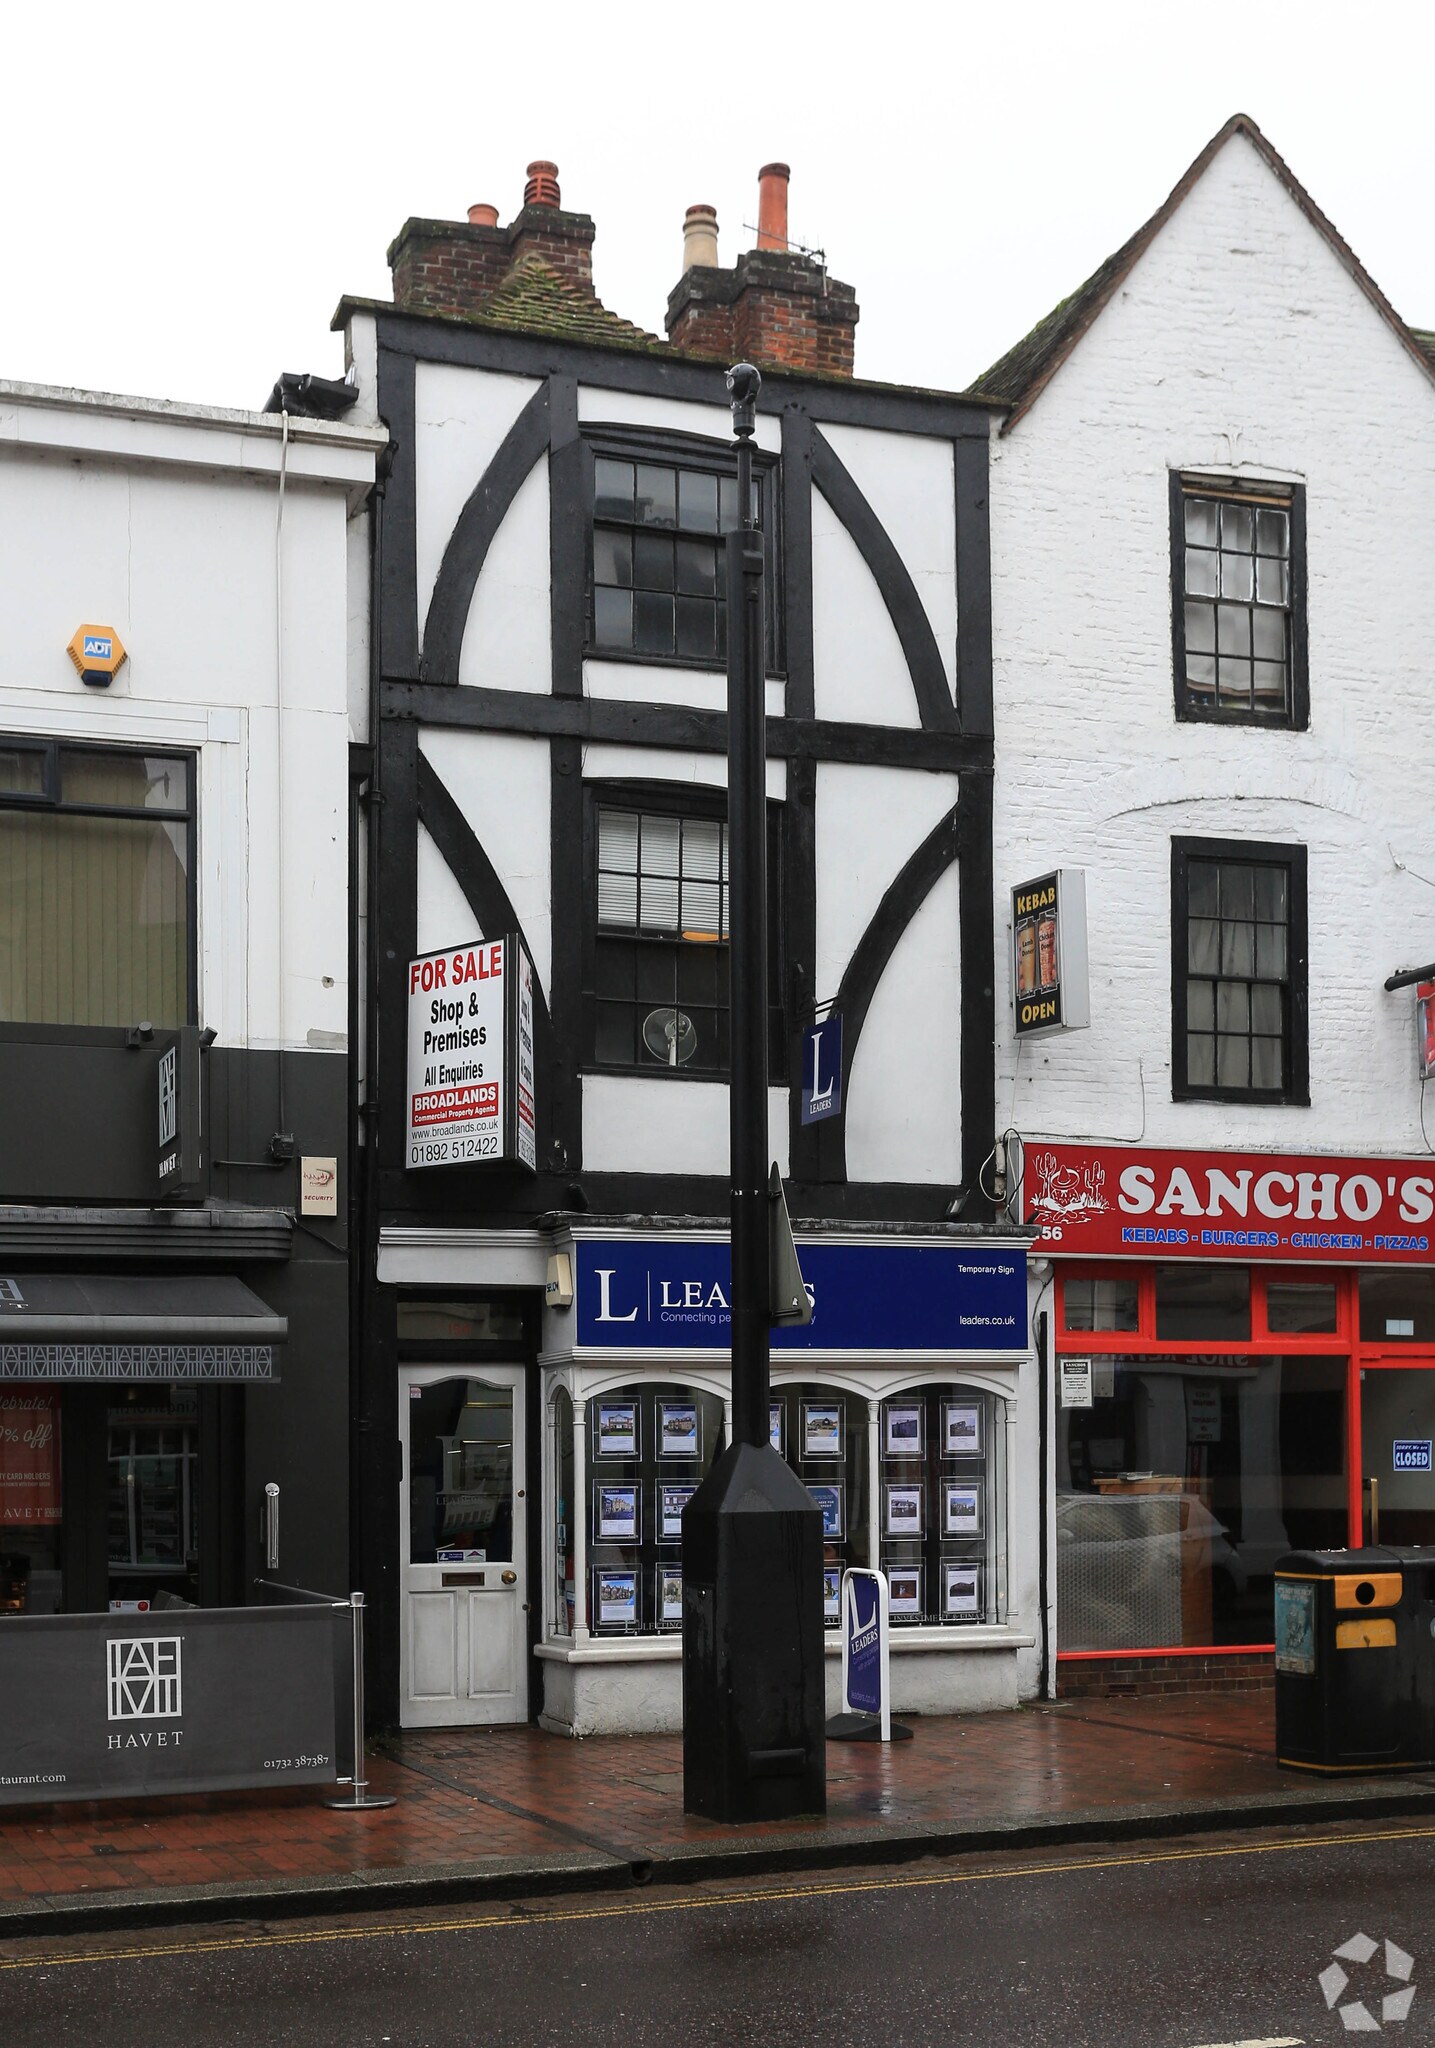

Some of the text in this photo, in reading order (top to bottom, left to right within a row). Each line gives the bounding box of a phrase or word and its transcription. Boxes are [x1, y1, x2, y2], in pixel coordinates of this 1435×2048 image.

[85, 641, 112, 655] ADT
[1017, 887, 1056, 915] KEBAB
[1022, 939, 1034, 948] Lamb
[410, 945, 502, 995] FOR SALE
[430, 992, 479, 1026] Shop &
[1021, 1000, 1055, 1024] OPEN
[423, 1024, 487, 1055] Premises
[424, 1060, 484, 1087] All Enquiries
[810, 1031, 834, 1102] L
[414, 1086, 496, 1111] BROADLANDS
[809, 1098, 832, 1115] LEADERS
[414, 1104, 496, 1122] Commercial Property Agents
[411, 1119, 499, 1140] www.broadlands.co.uk
[411, 1136, 498, 1164] 01892 512422
[159, 1152, 177, 1178] HAVET
[1117, 1165, 1434, 1224] SANCHO'S
[1036, 1226, 1063, 1241] 56
[1121, 1227, 1189, 1245] KEBABS
[1202, 1230, 1279, 1247] BURGERS
[1291, 1232, 1363, 1249] CHICKEN
[1375, 1236, 1429, 1250] PIZZAS
[958, 1264, 1015, 1275] Temporary Sign
[594, 1269, 639, 1322] L
[660, 1281, 816, 1308] LEAS
[660, 1311, 717, 1325] Connecting
[959, 1315, 1016, 1325] leaders.co.uk
[23, 1424, 53, 1449] off
[1395, 1452, 1428, 1466] CLOSED
[7, 1472, 23, 1480] CARD
[23, 1472, 50, 1480] HOLDERS
[0, 1508, 43, 1518] AVET
[848, 1577, 877, 1641] L
[851, 1628, 879, 1655] LEADERS
[107, 1731, 183, 1749] HAVET
[263, 1754, 329, 1769] 01732 387387
